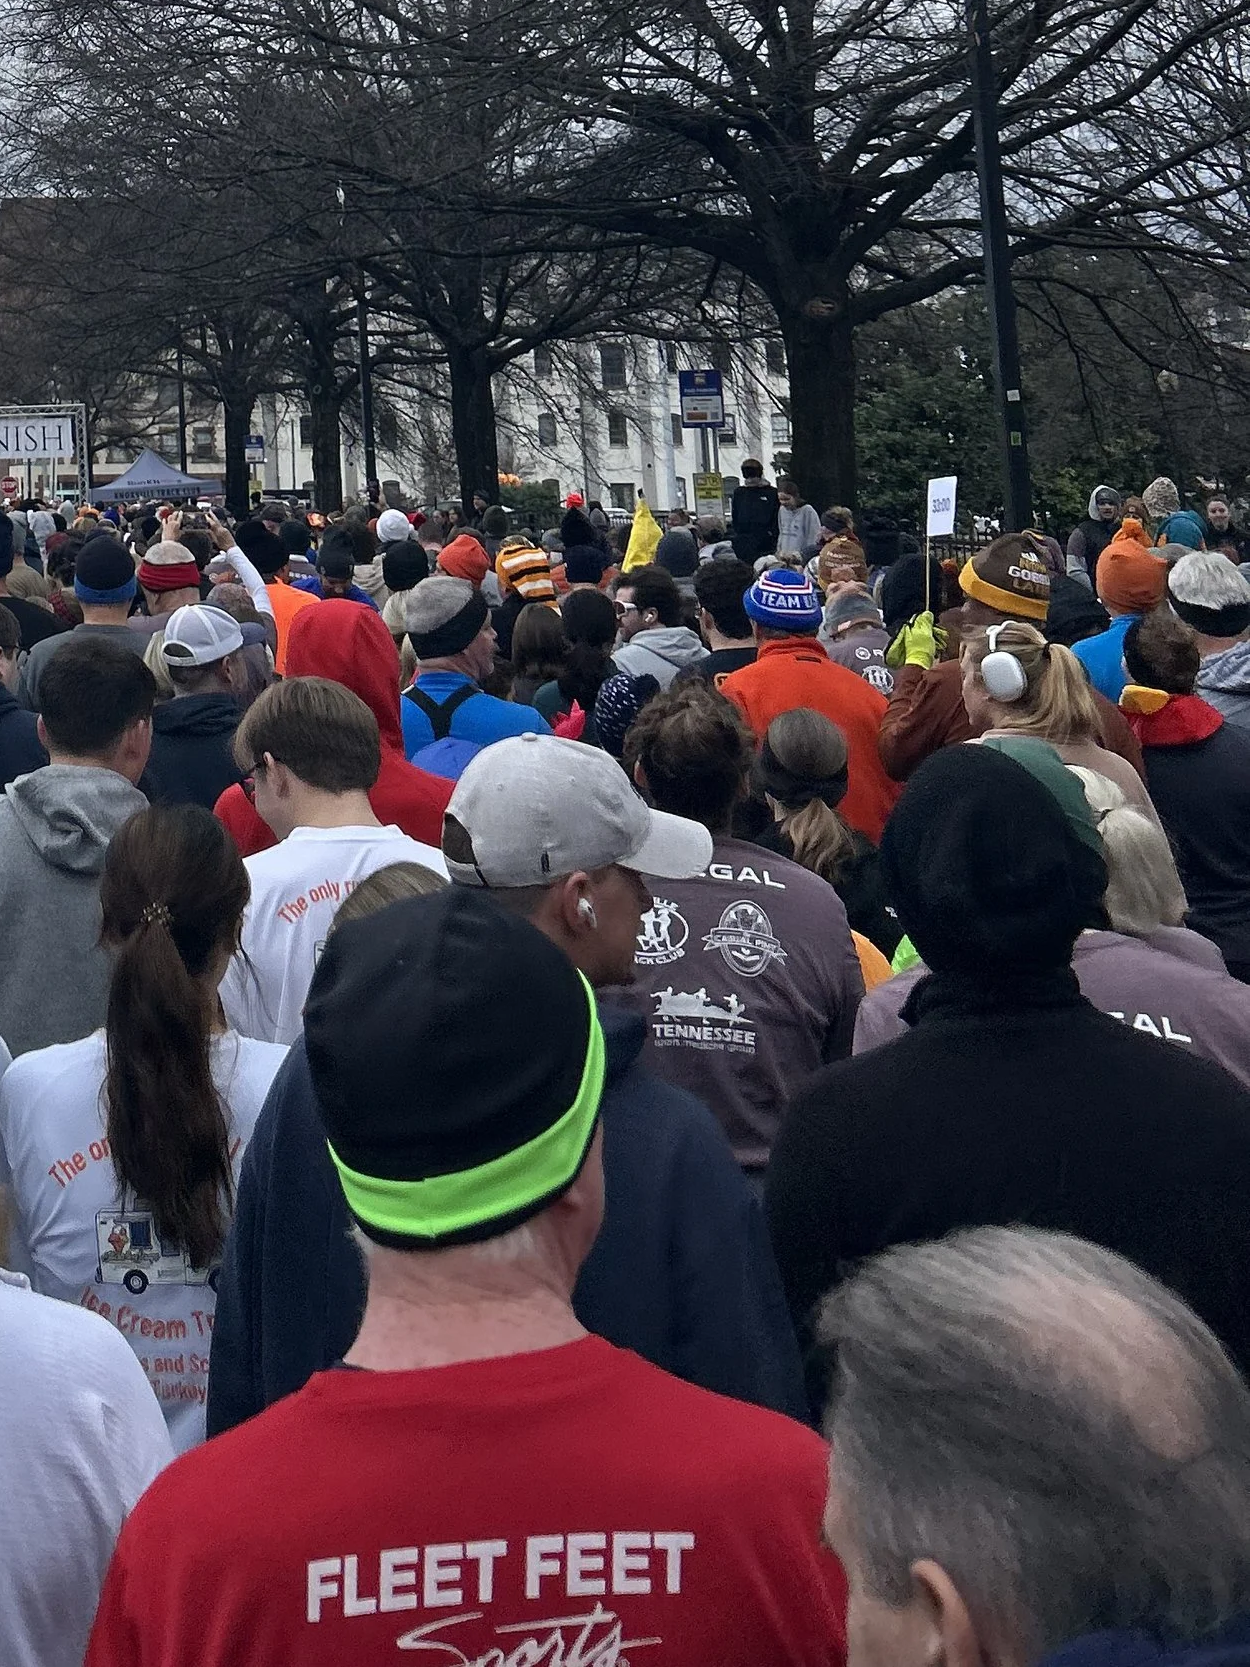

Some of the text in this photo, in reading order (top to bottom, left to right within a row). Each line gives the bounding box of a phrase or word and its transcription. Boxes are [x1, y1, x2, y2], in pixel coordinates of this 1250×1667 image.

[1, 480, 17, 489] STOP
[157, 487, 180, 496] TRACK
[183, 486, 201, 495] CLUB
[761, 591, 801, 608] TEAM
[277, 895, 309, 924] The
[309, 878, 340, 902] only
[655, 947, 686, 964] CLUB
[652, 1023, 756, 1046] TENNESSEE
[48, 1149, 87, 1189] The
[80, 1286, 111, 1319] Ice
[116, 1304, 187, 1340] Cream
[154, 1354, 185, 1374] and
[306, 1531, 696, 1624] FLEET FEET
